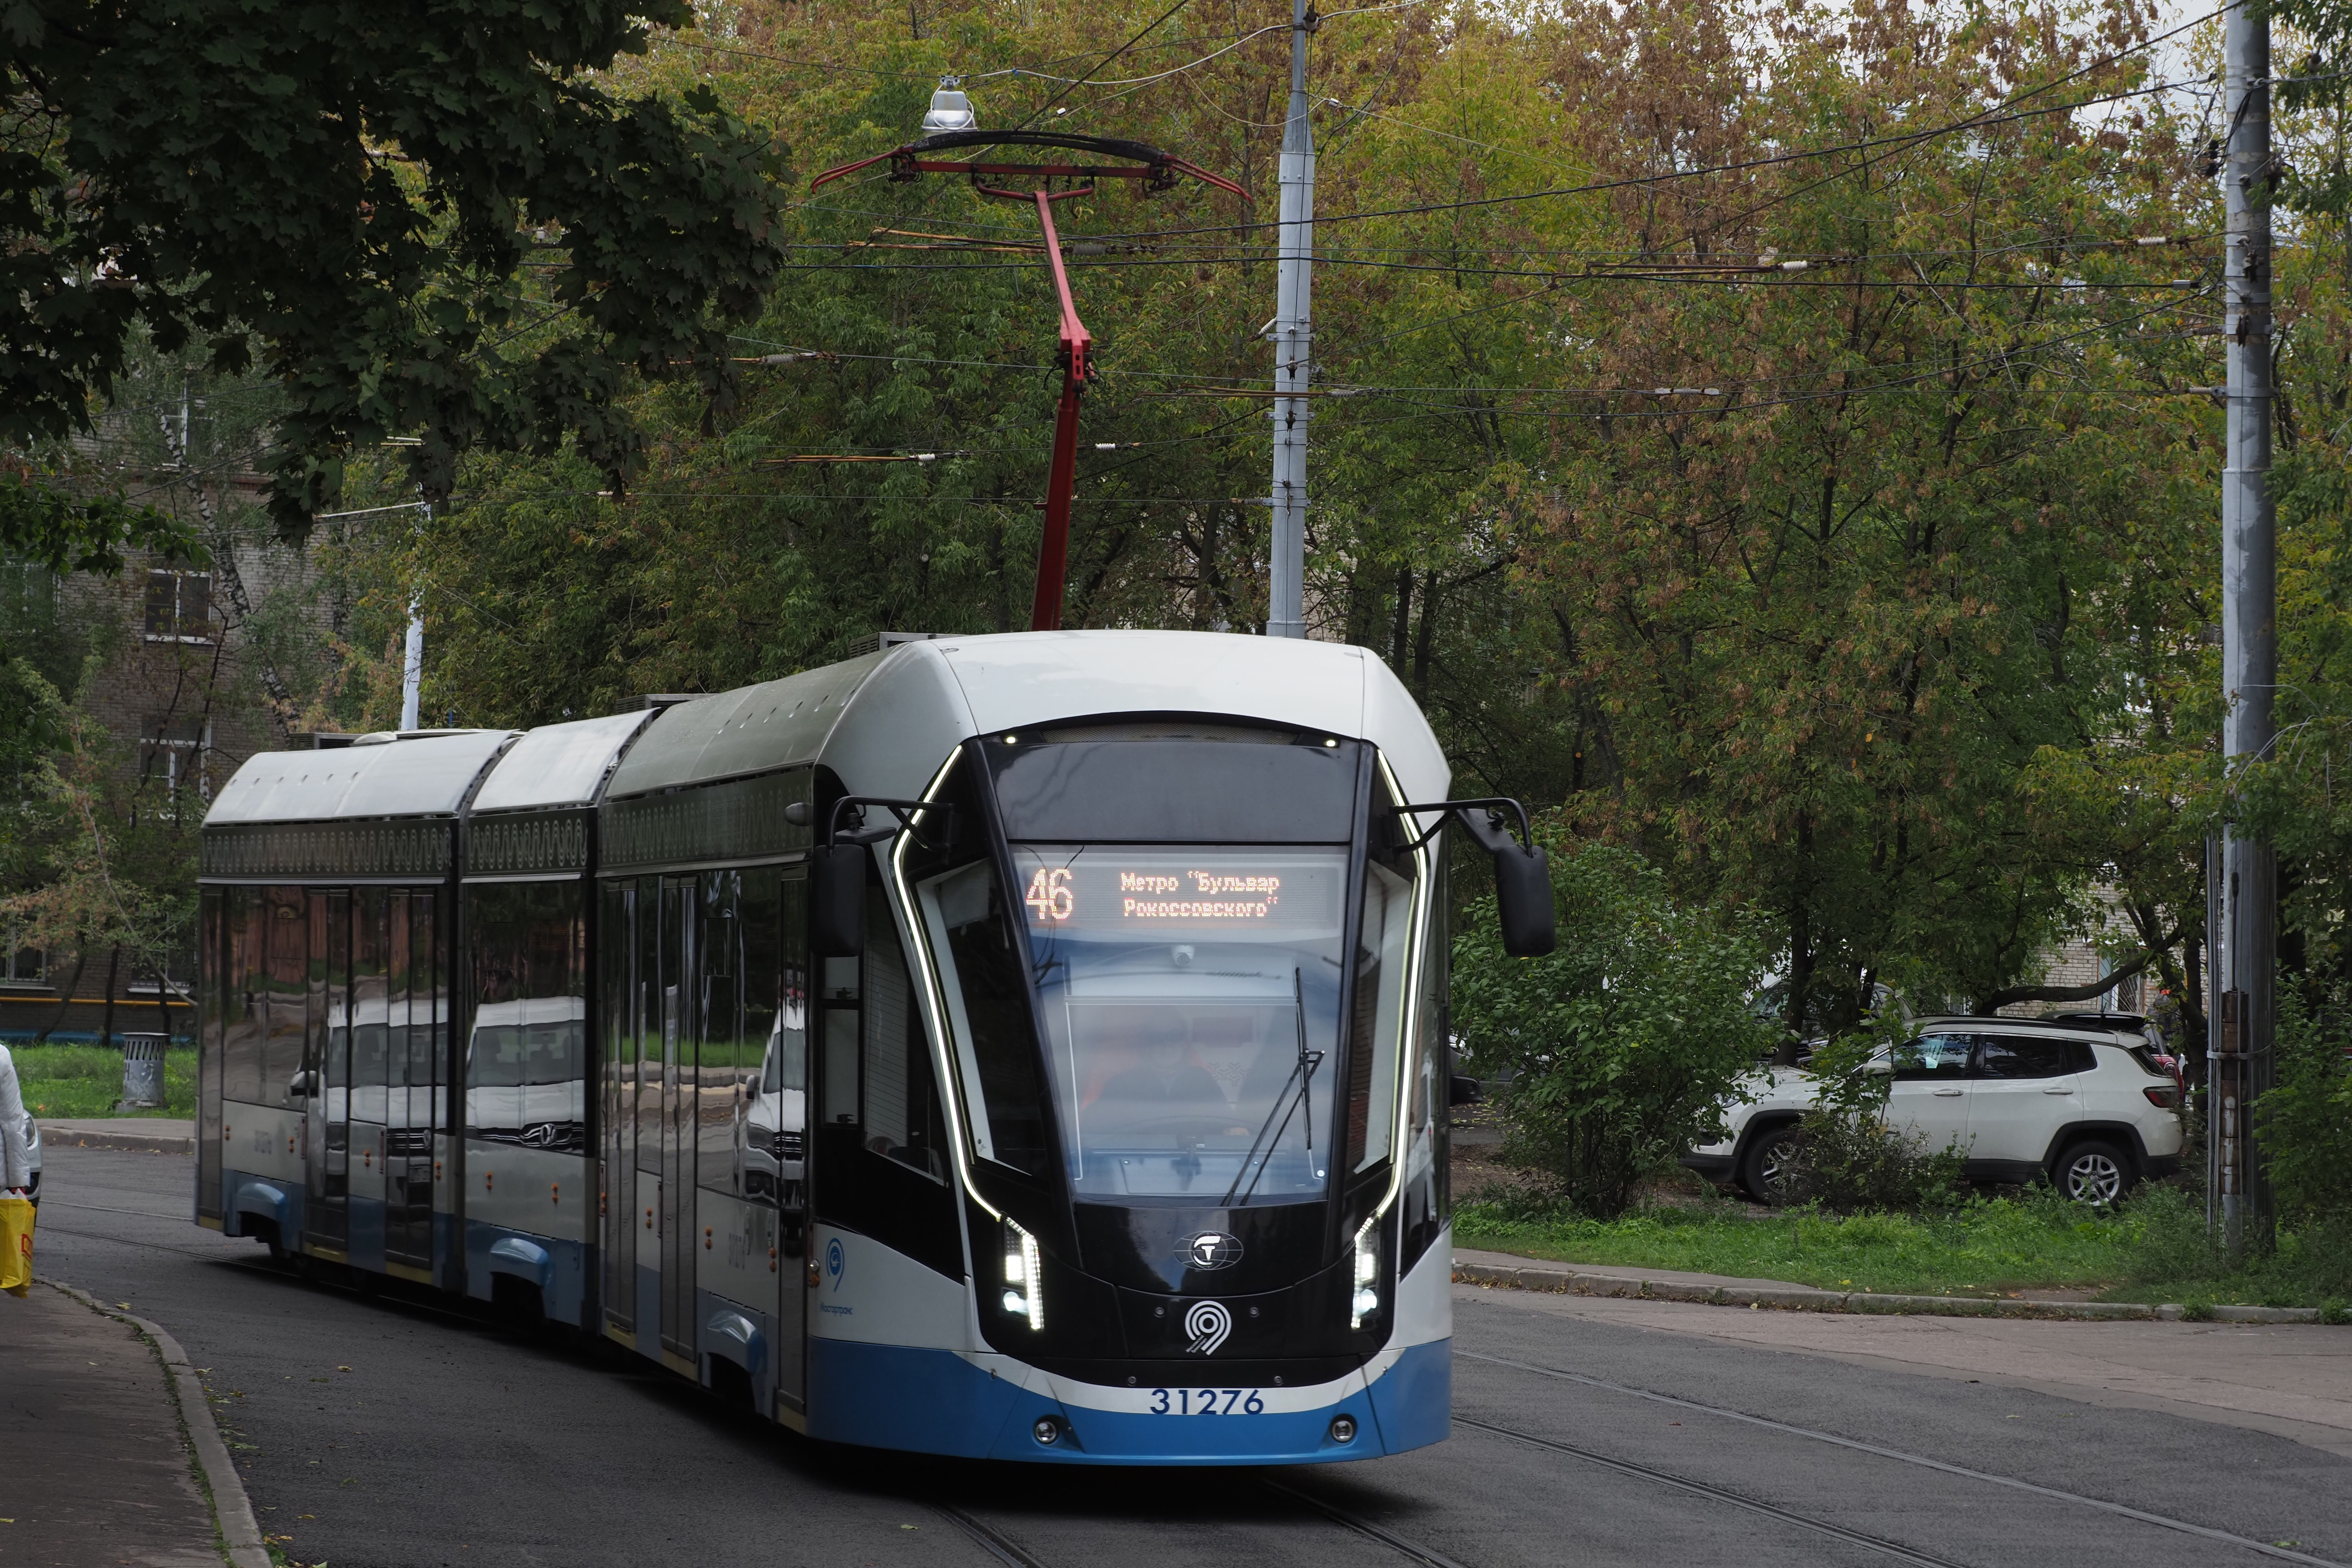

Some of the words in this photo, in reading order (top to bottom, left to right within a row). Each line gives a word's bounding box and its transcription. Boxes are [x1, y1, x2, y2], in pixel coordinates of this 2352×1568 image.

[1026, 869, 1073, 919] 46
[1121, 872, 1178, 894] Метро
[1150, 1388, 1264, 1415] 31276
